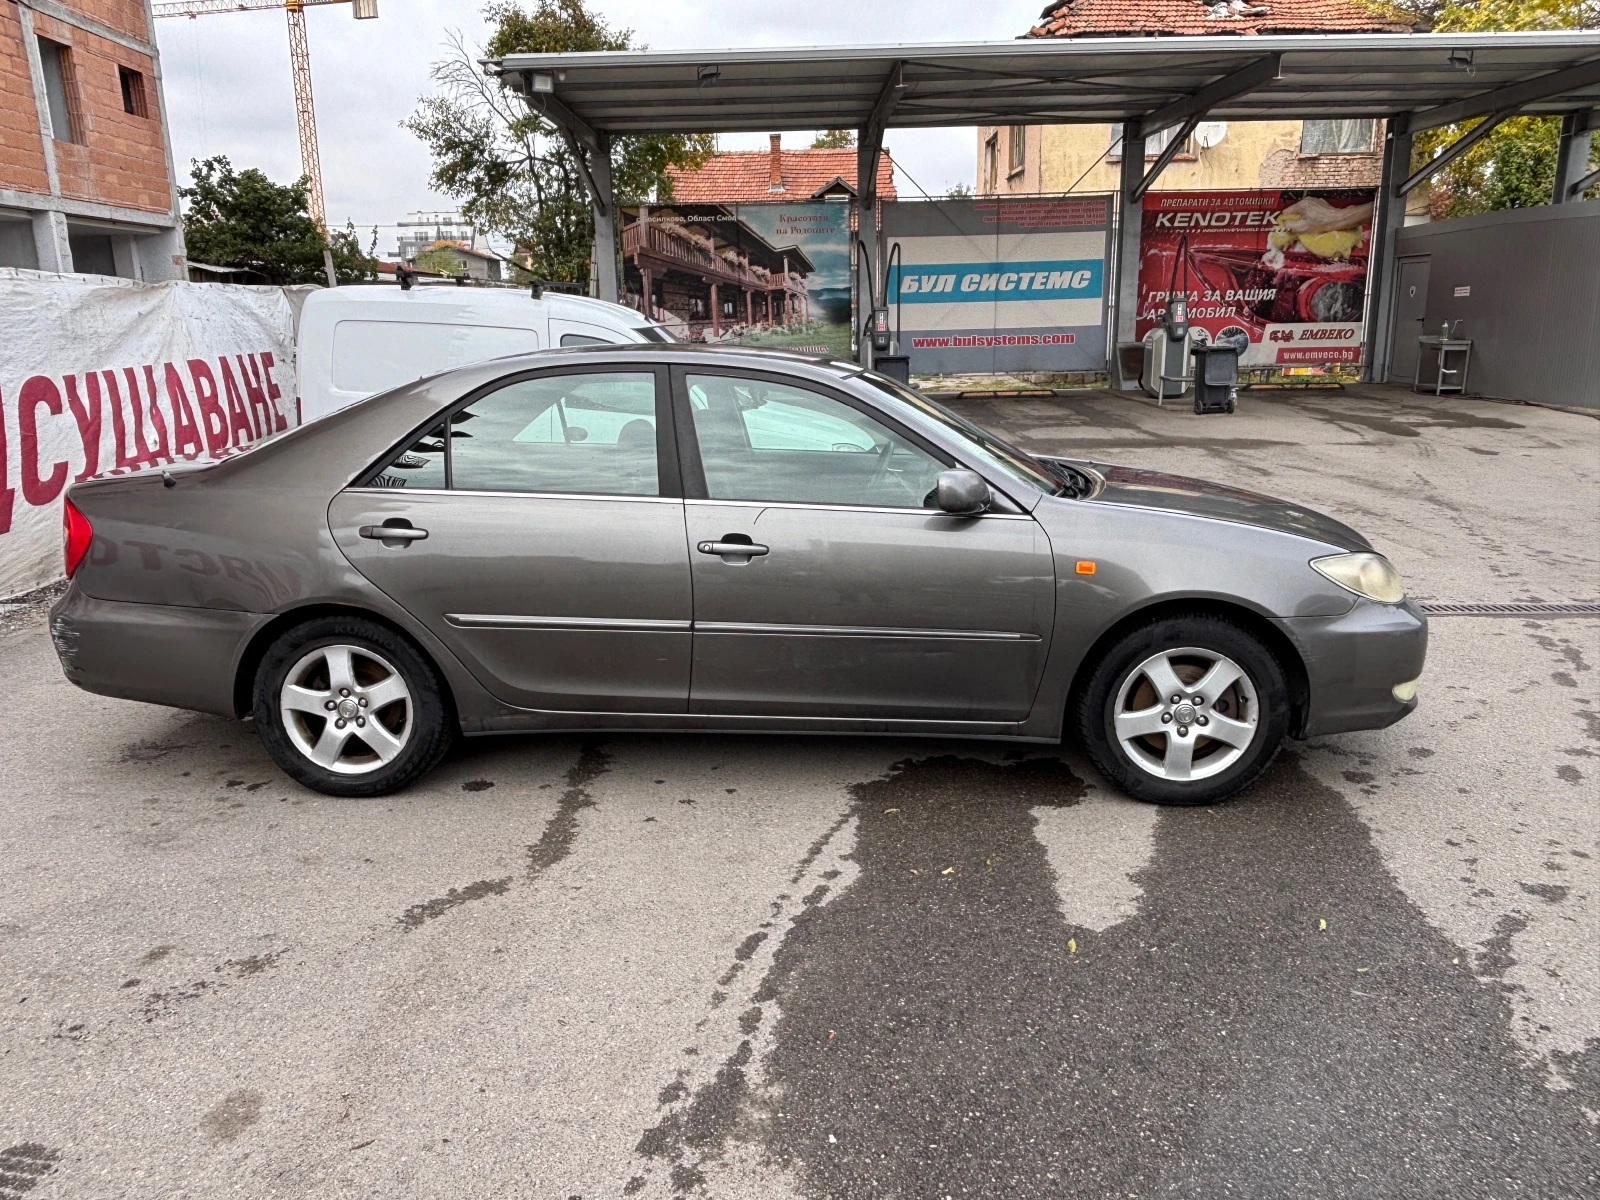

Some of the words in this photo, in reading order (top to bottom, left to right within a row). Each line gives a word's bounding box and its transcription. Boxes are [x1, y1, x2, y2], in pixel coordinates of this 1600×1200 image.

[1160, 198, 1208, 207] ПРЕПАРАТИ
[1210, 198, 1221, 206] ЗА
[1223, 197, 1275, 206] АВТОМИВКИ
[1155, 210, 1281, 228] KENOTEK
[900, 274, 957, 294] БУЛ
[960, 270, 1092, 292] СИСТЕМС
[1202, 289, 1221, 302] ЗА
[1225, 288, 1277, 302] ВАШИЯ
[1146, 306, 1236, 320] АВМОБИЛ
[912, 333, 1076, 349] www.bulsystems.com
[1283, 349, 1354, 360] www.emveco.bg
[334, 623, 396, 650] KUMHO
